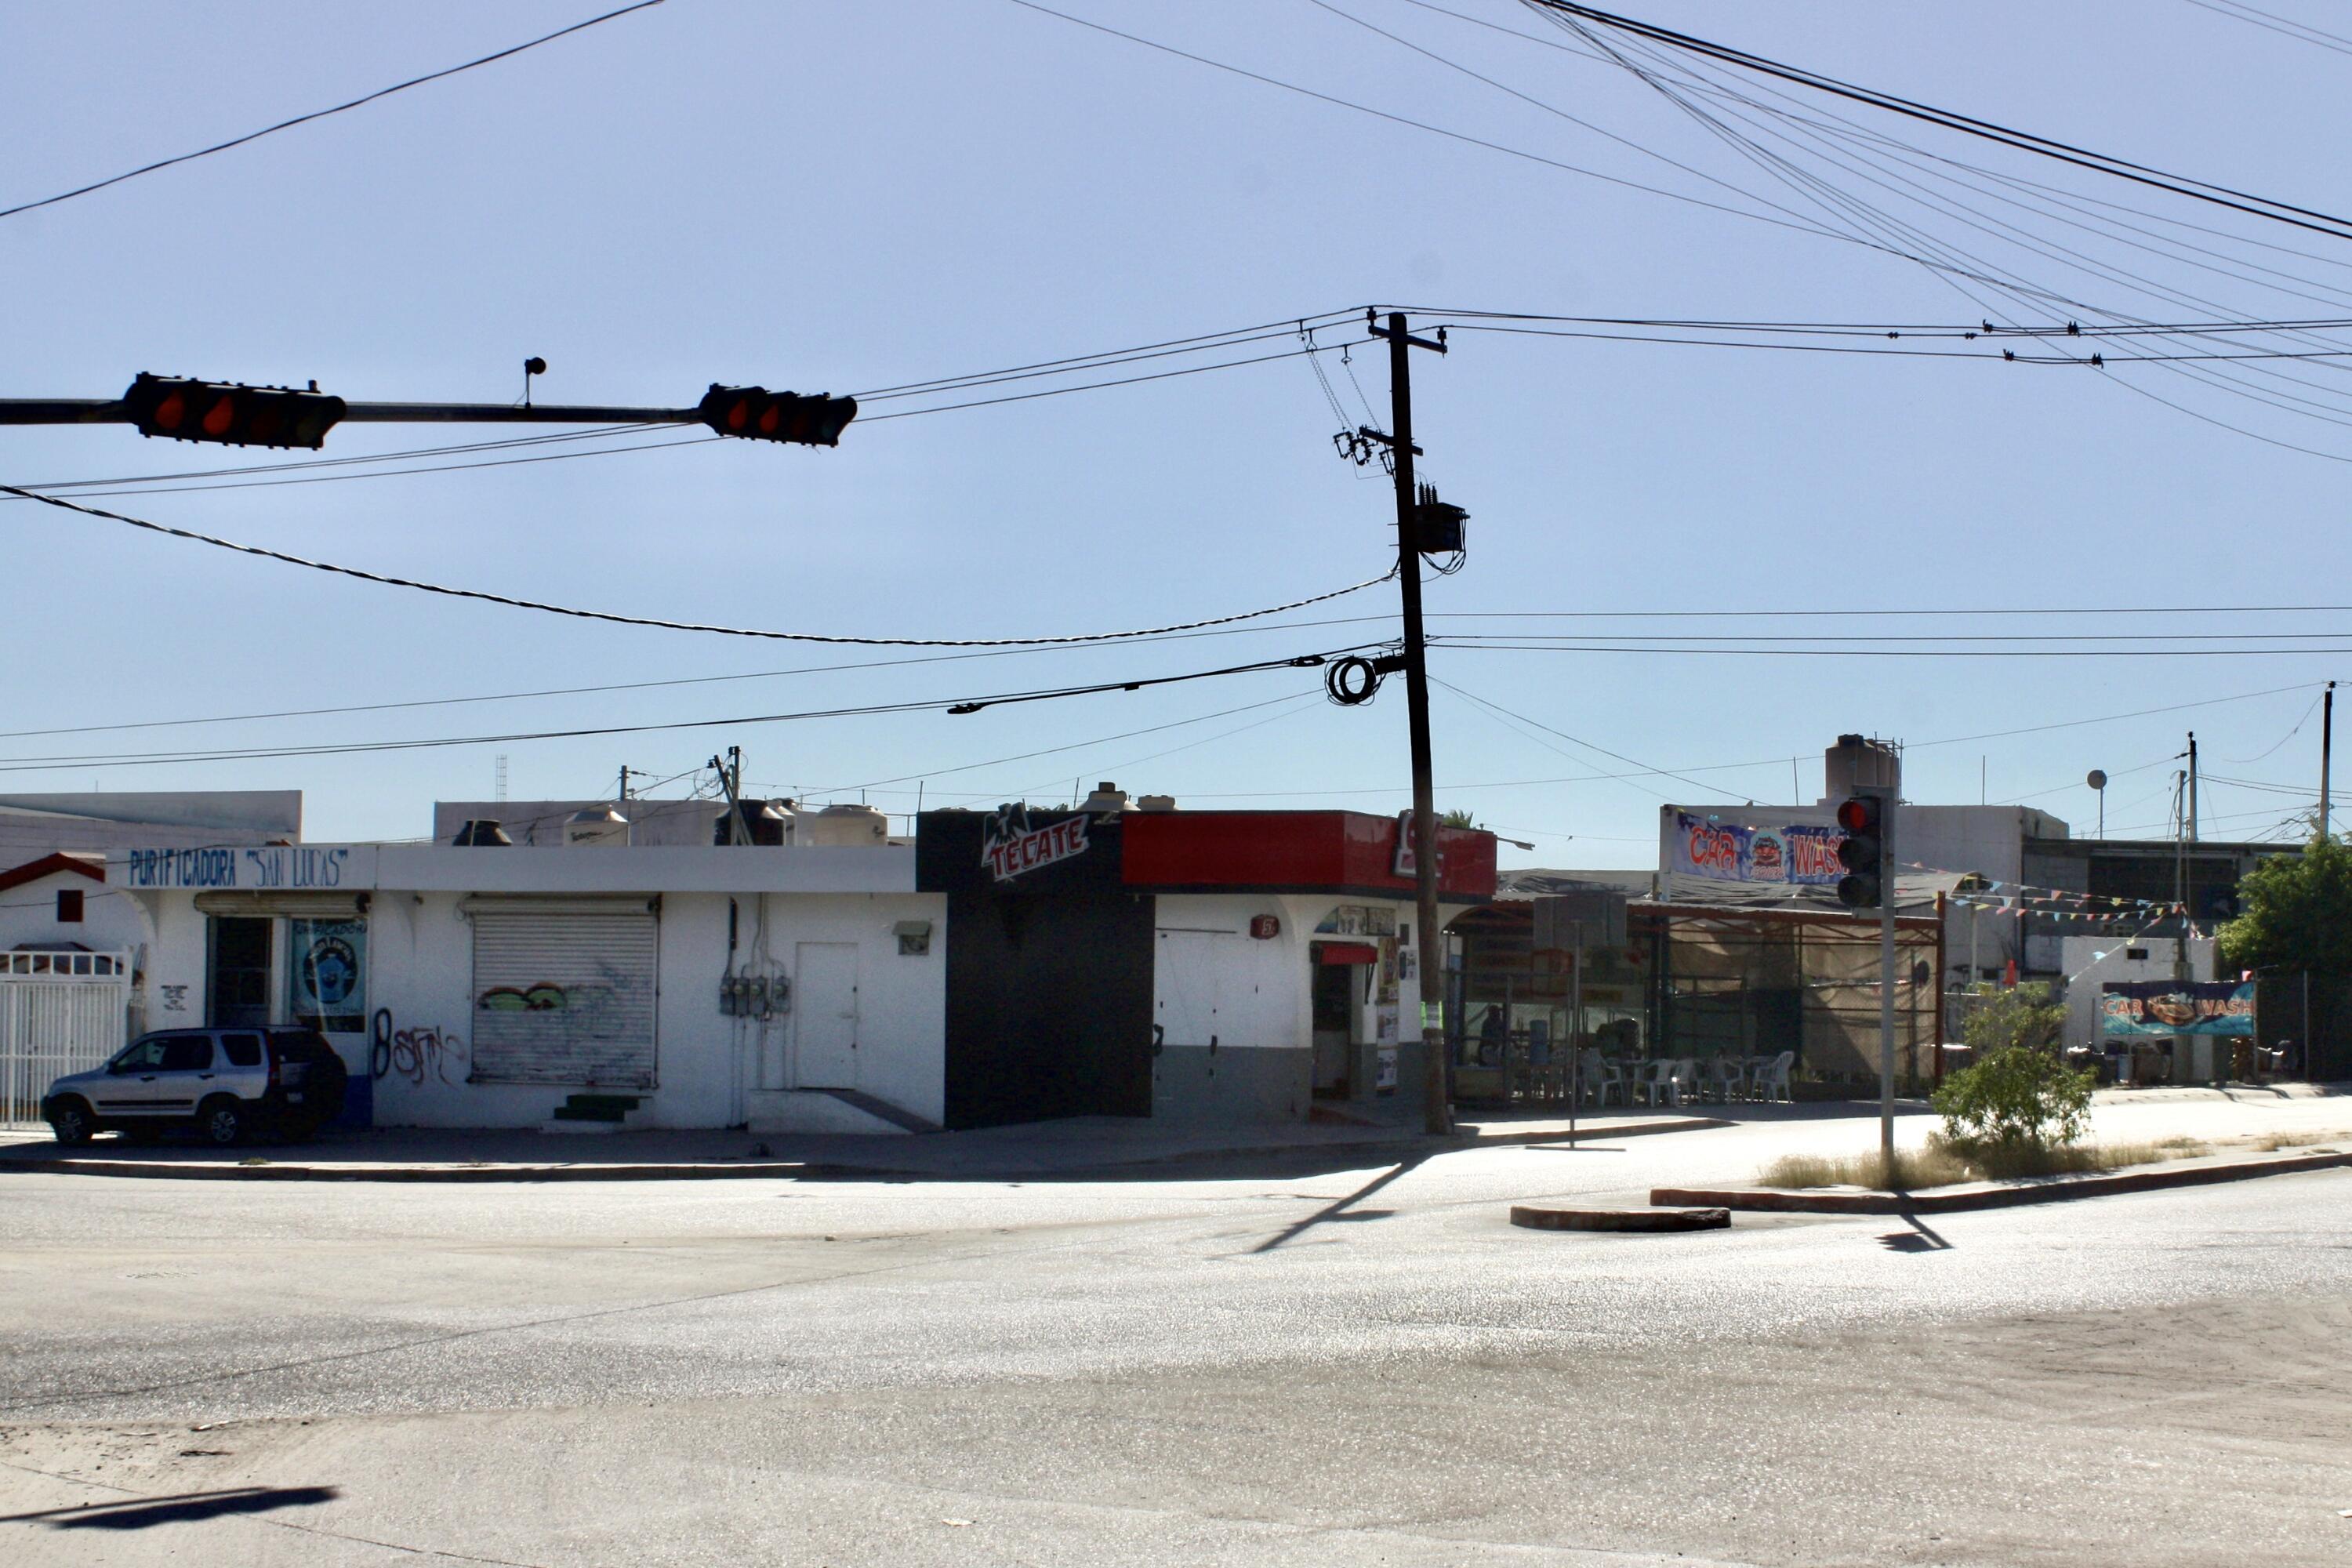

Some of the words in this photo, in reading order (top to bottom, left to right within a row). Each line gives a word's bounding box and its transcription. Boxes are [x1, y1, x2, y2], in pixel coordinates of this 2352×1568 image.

[129, 849, 235, 886] PURIFICADORA
[989, 817, 1083, 877] TECATE
[1690, 826, 1736, 871] CAR
[2103, 998, 2144, 1016] CAR
[2195, 998, 2256, 1016] WASH
